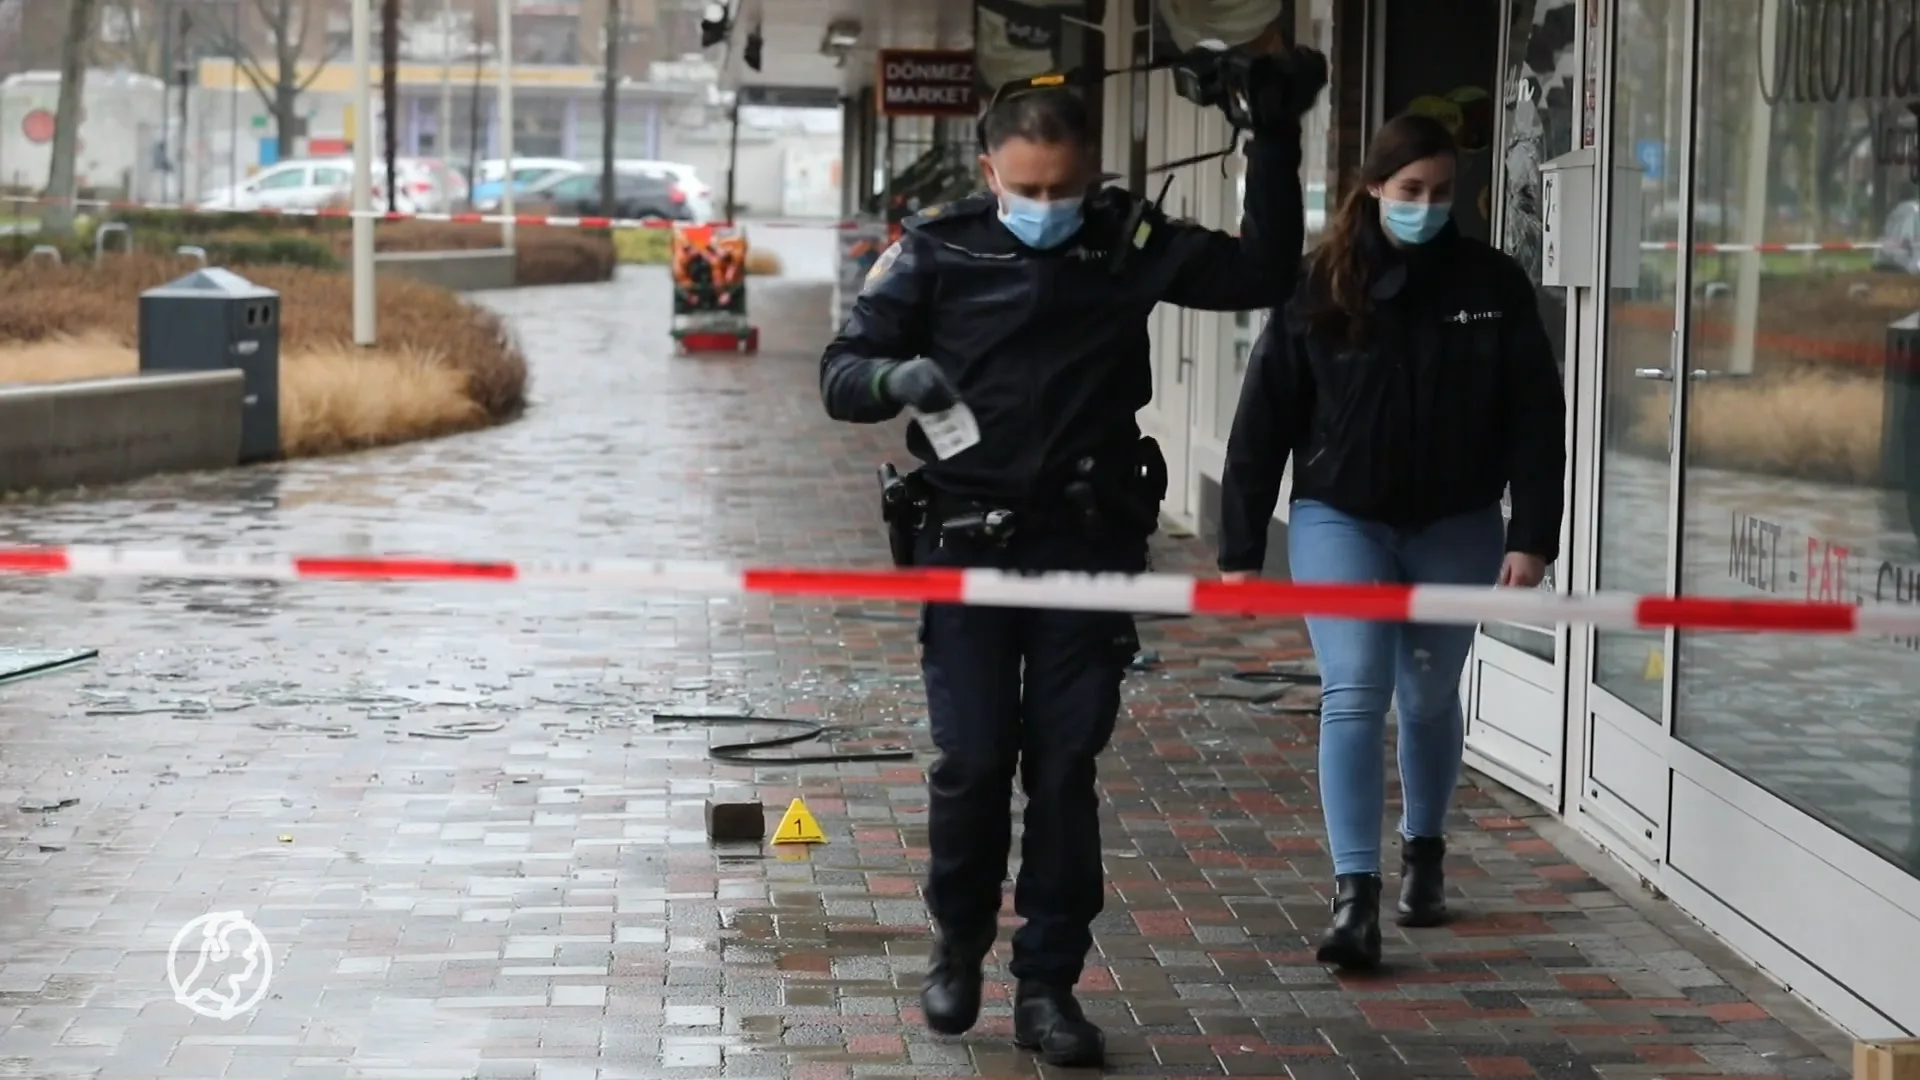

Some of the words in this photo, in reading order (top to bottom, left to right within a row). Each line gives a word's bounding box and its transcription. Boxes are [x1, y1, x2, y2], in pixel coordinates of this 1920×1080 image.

[887, 60, 972, 81] DÖNMEZ
[887, 86, 970, 104] MARKET
[1729, 511, 1781, 593] MEET
[1806, 536, 1849, 606] EAT
[794, 817, 801, 835] 1
